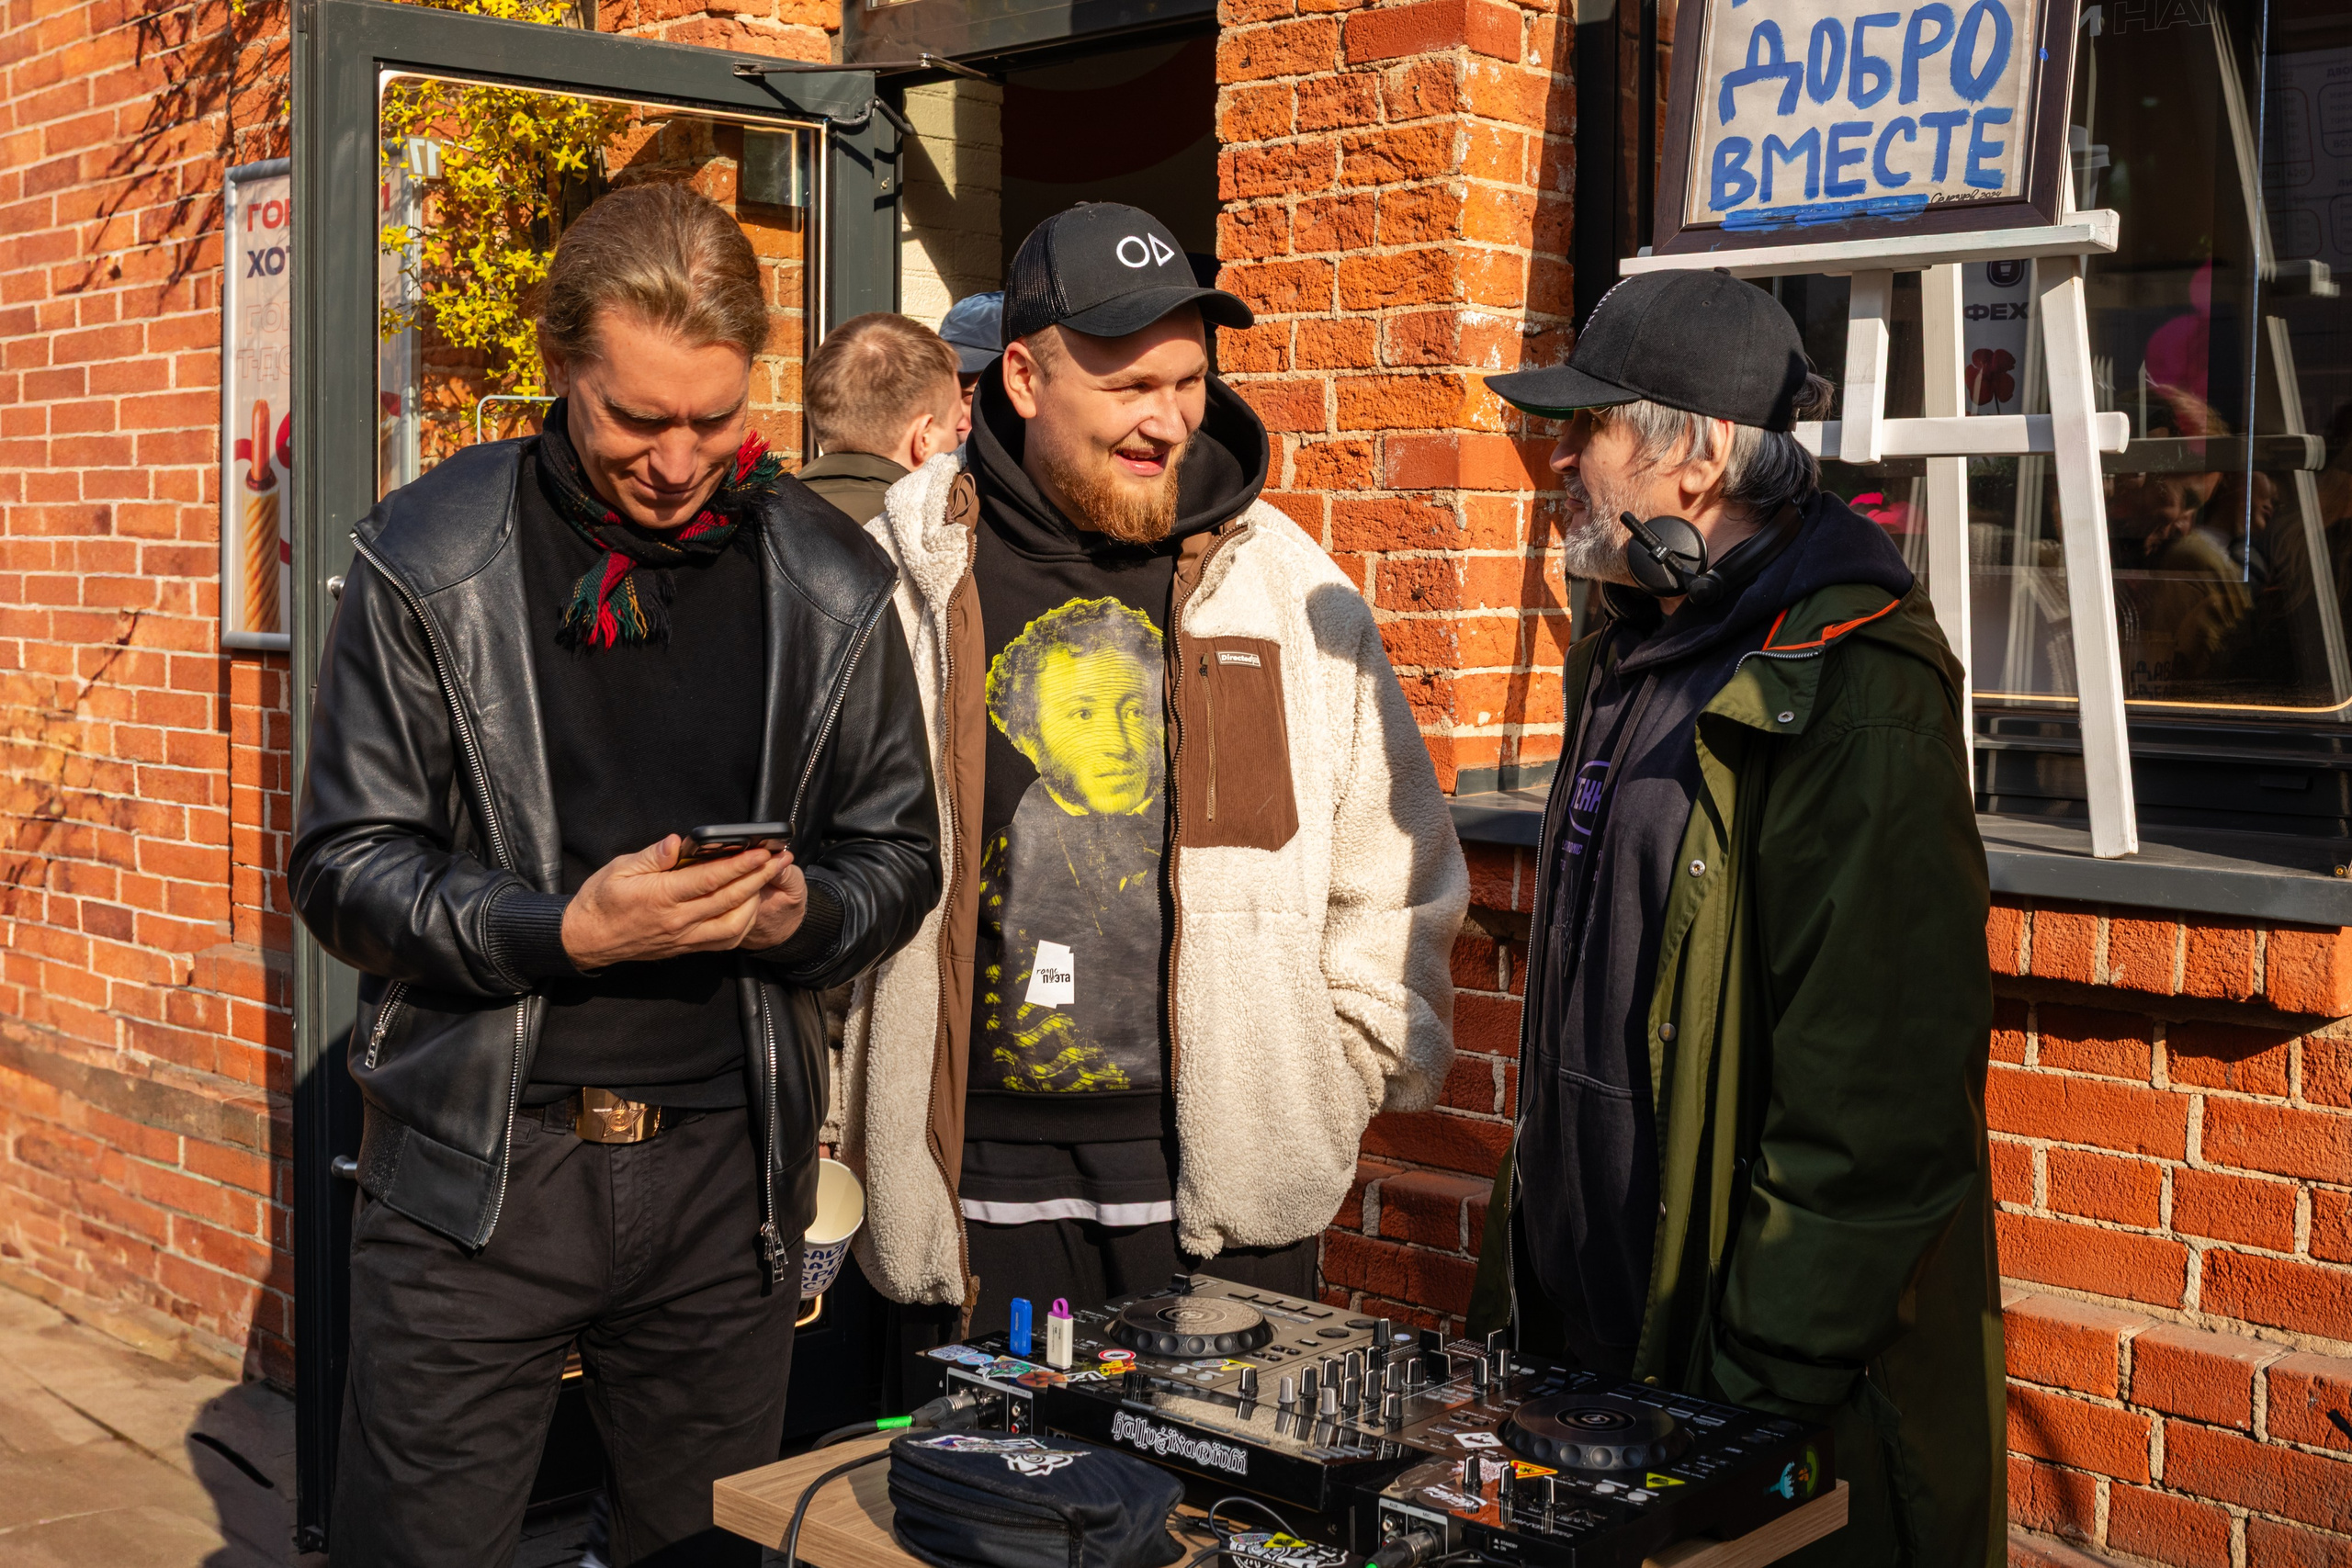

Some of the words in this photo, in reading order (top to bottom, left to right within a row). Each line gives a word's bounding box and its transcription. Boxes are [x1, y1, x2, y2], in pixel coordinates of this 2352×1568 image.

[1718, 0, 2014, 126] ДОБРО
[1708, 107, 2013, 212] ВМЕСТЕ
[1978, 190, 2003, 199] 2024
[246, 245, 290, 279] ХО
[1221, 654, 1252, 662] Directed
